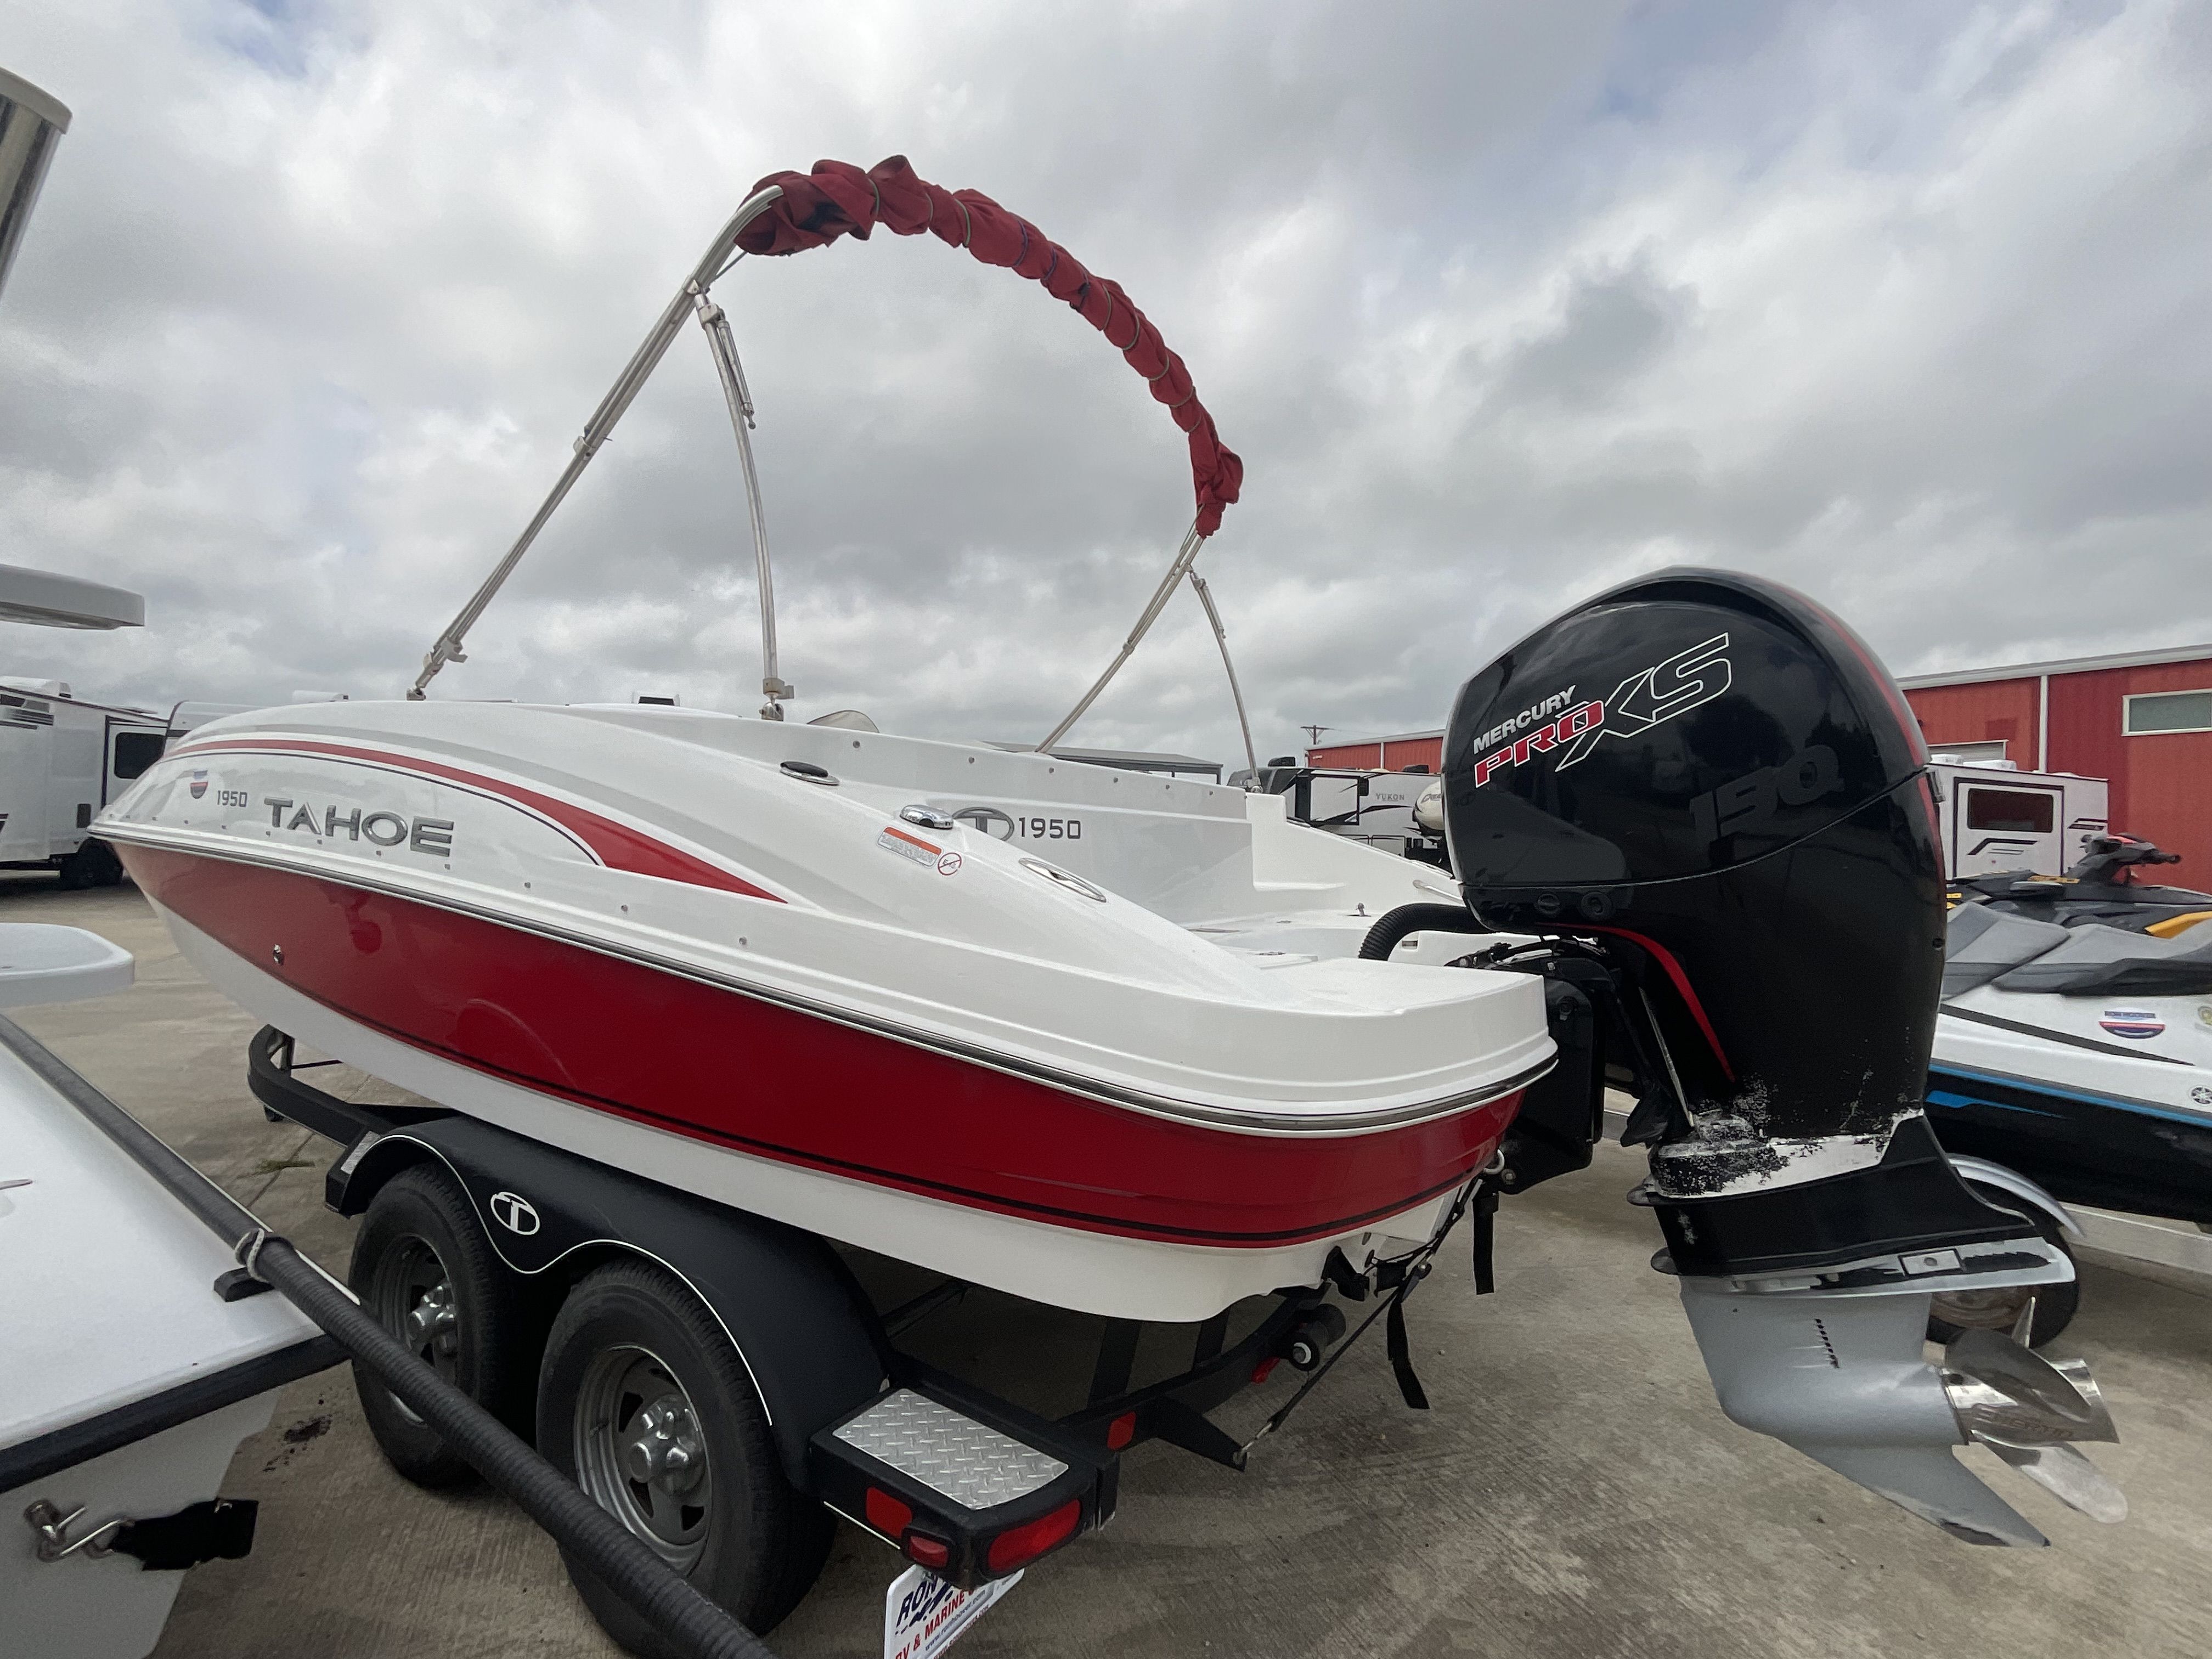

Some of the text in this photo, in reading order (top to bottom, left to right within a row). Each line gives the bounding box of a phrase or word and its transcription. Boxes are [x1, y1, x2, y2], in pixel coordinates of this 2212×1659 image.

[1474, 632, 1731, 788] PRO XS
[1474, 685, 1576, 754] MERCURY
[217, 790, 247, 807] 1950
[263, 796, 454, 857] TAHOE
[1019, 817, 1081, 839] 1950
[896, 1574, 938, 1628] RON
[913, 1634, 921, 1651] &
[925, 1590, 964, 1640] MARINE
